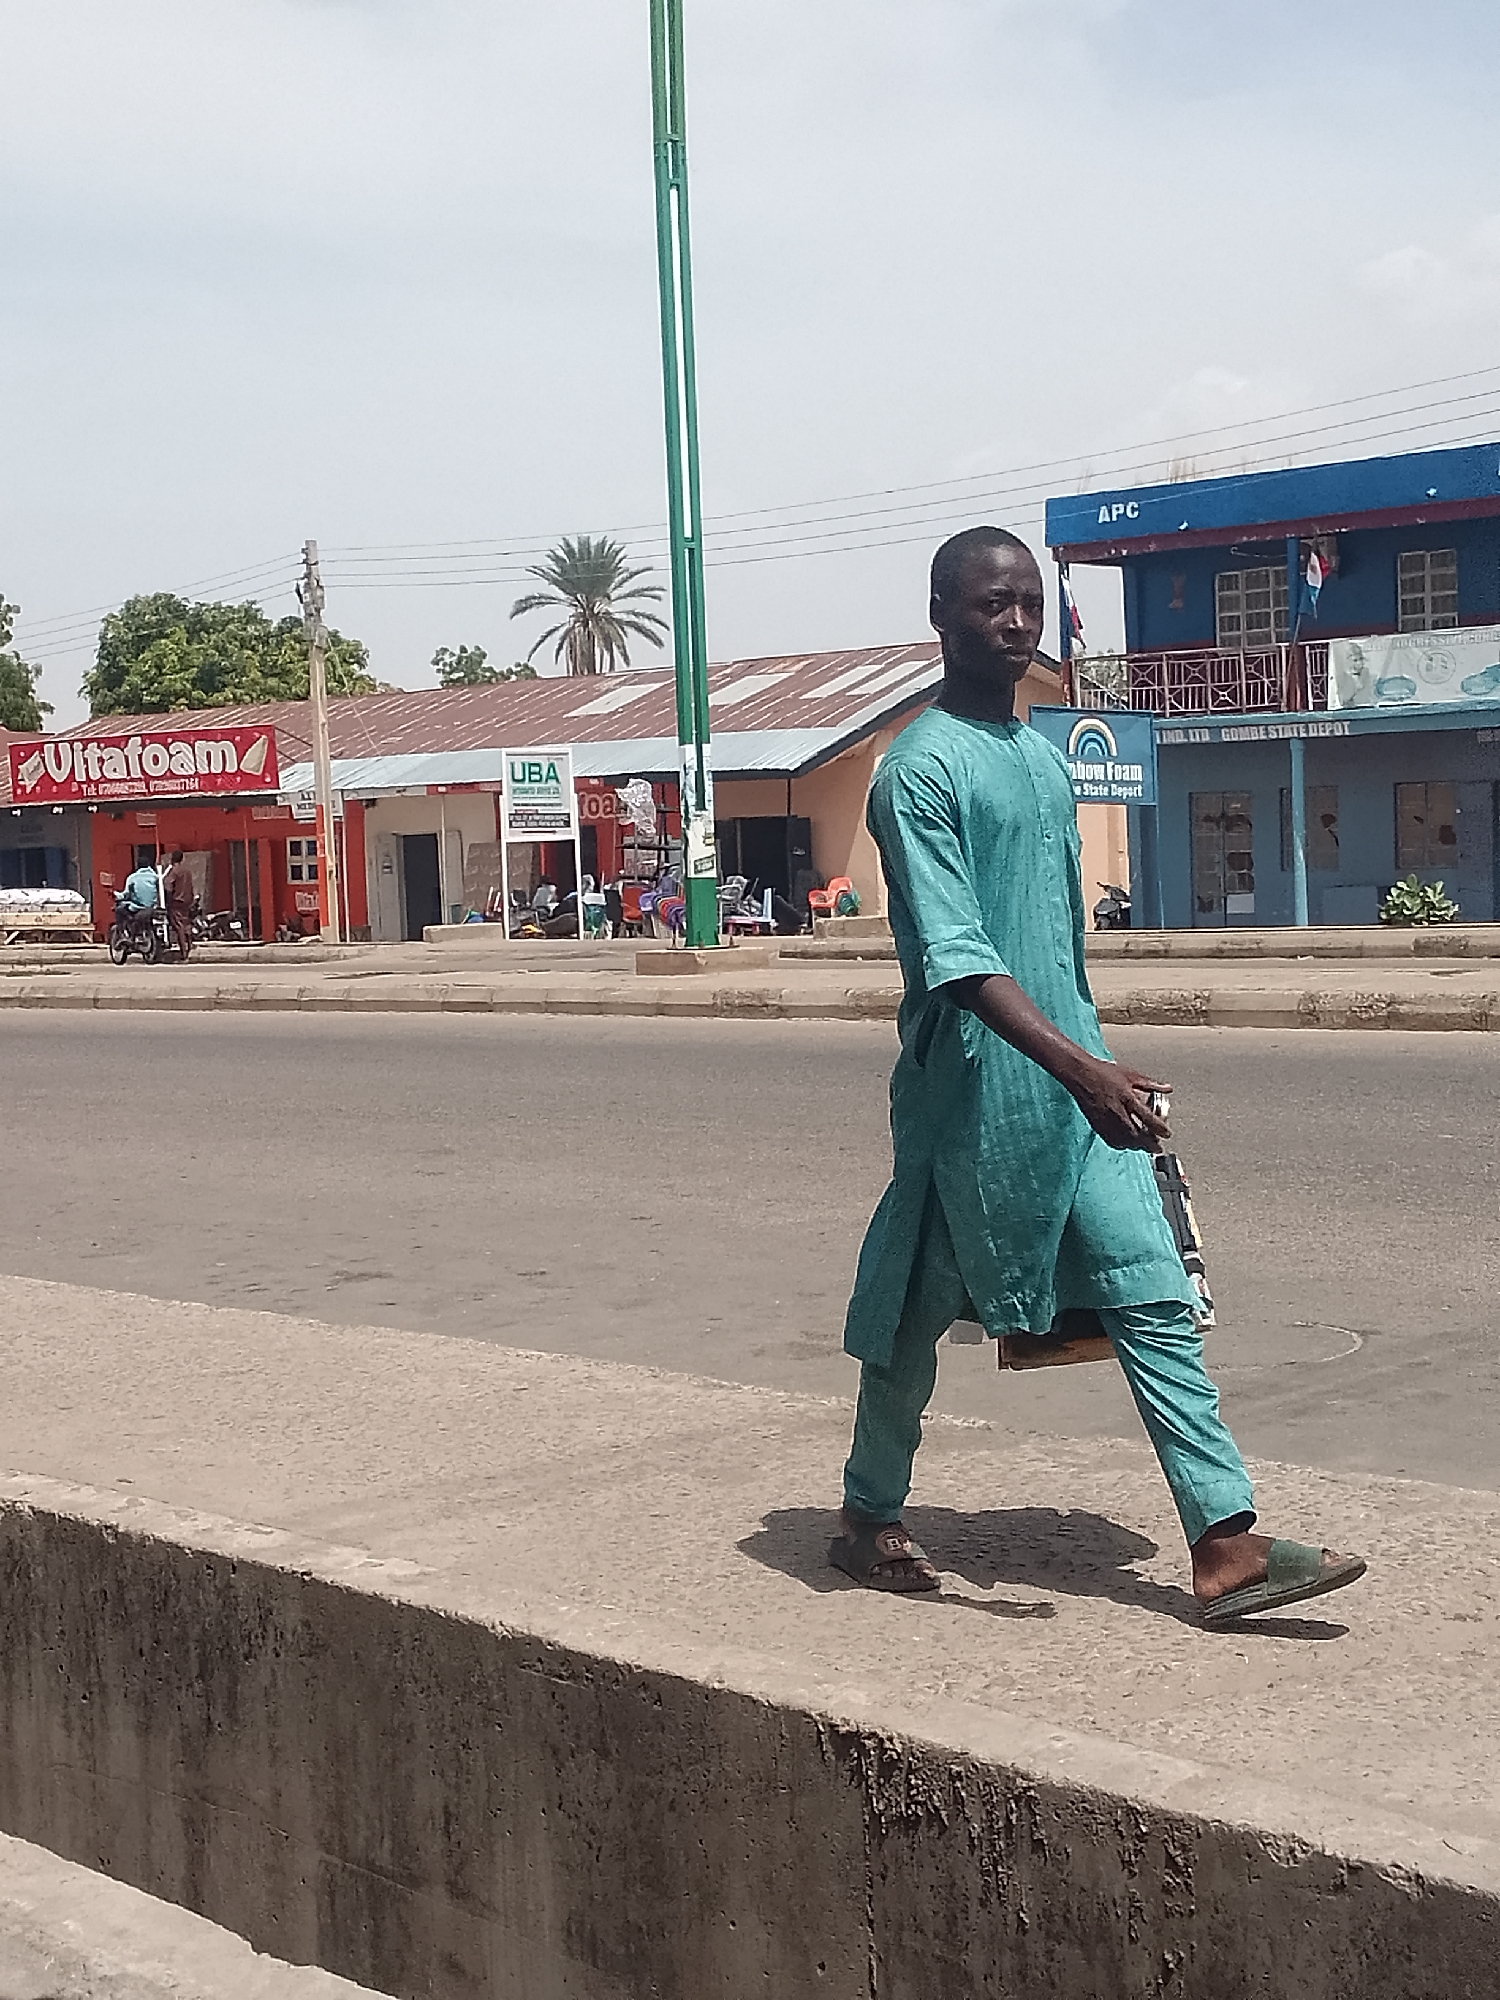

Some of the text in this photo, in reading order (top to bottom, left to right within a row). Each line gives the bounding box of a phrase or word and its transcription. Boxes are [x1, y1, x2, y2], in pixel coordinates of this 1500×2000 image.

[1098, 502, 1139, 523] APC
[1221, 726, 1266, 742] GOMBE
[1268, 723, 1306, 739] STATE
[1308, 721, 1350, 737] DEPOT
[44, 736, 238, 782] Vitafoam
[510, 762, 561, 784] UBA
[1106, 761, 1142, 781] Foam
[1083, 783, 1109, 796] State
